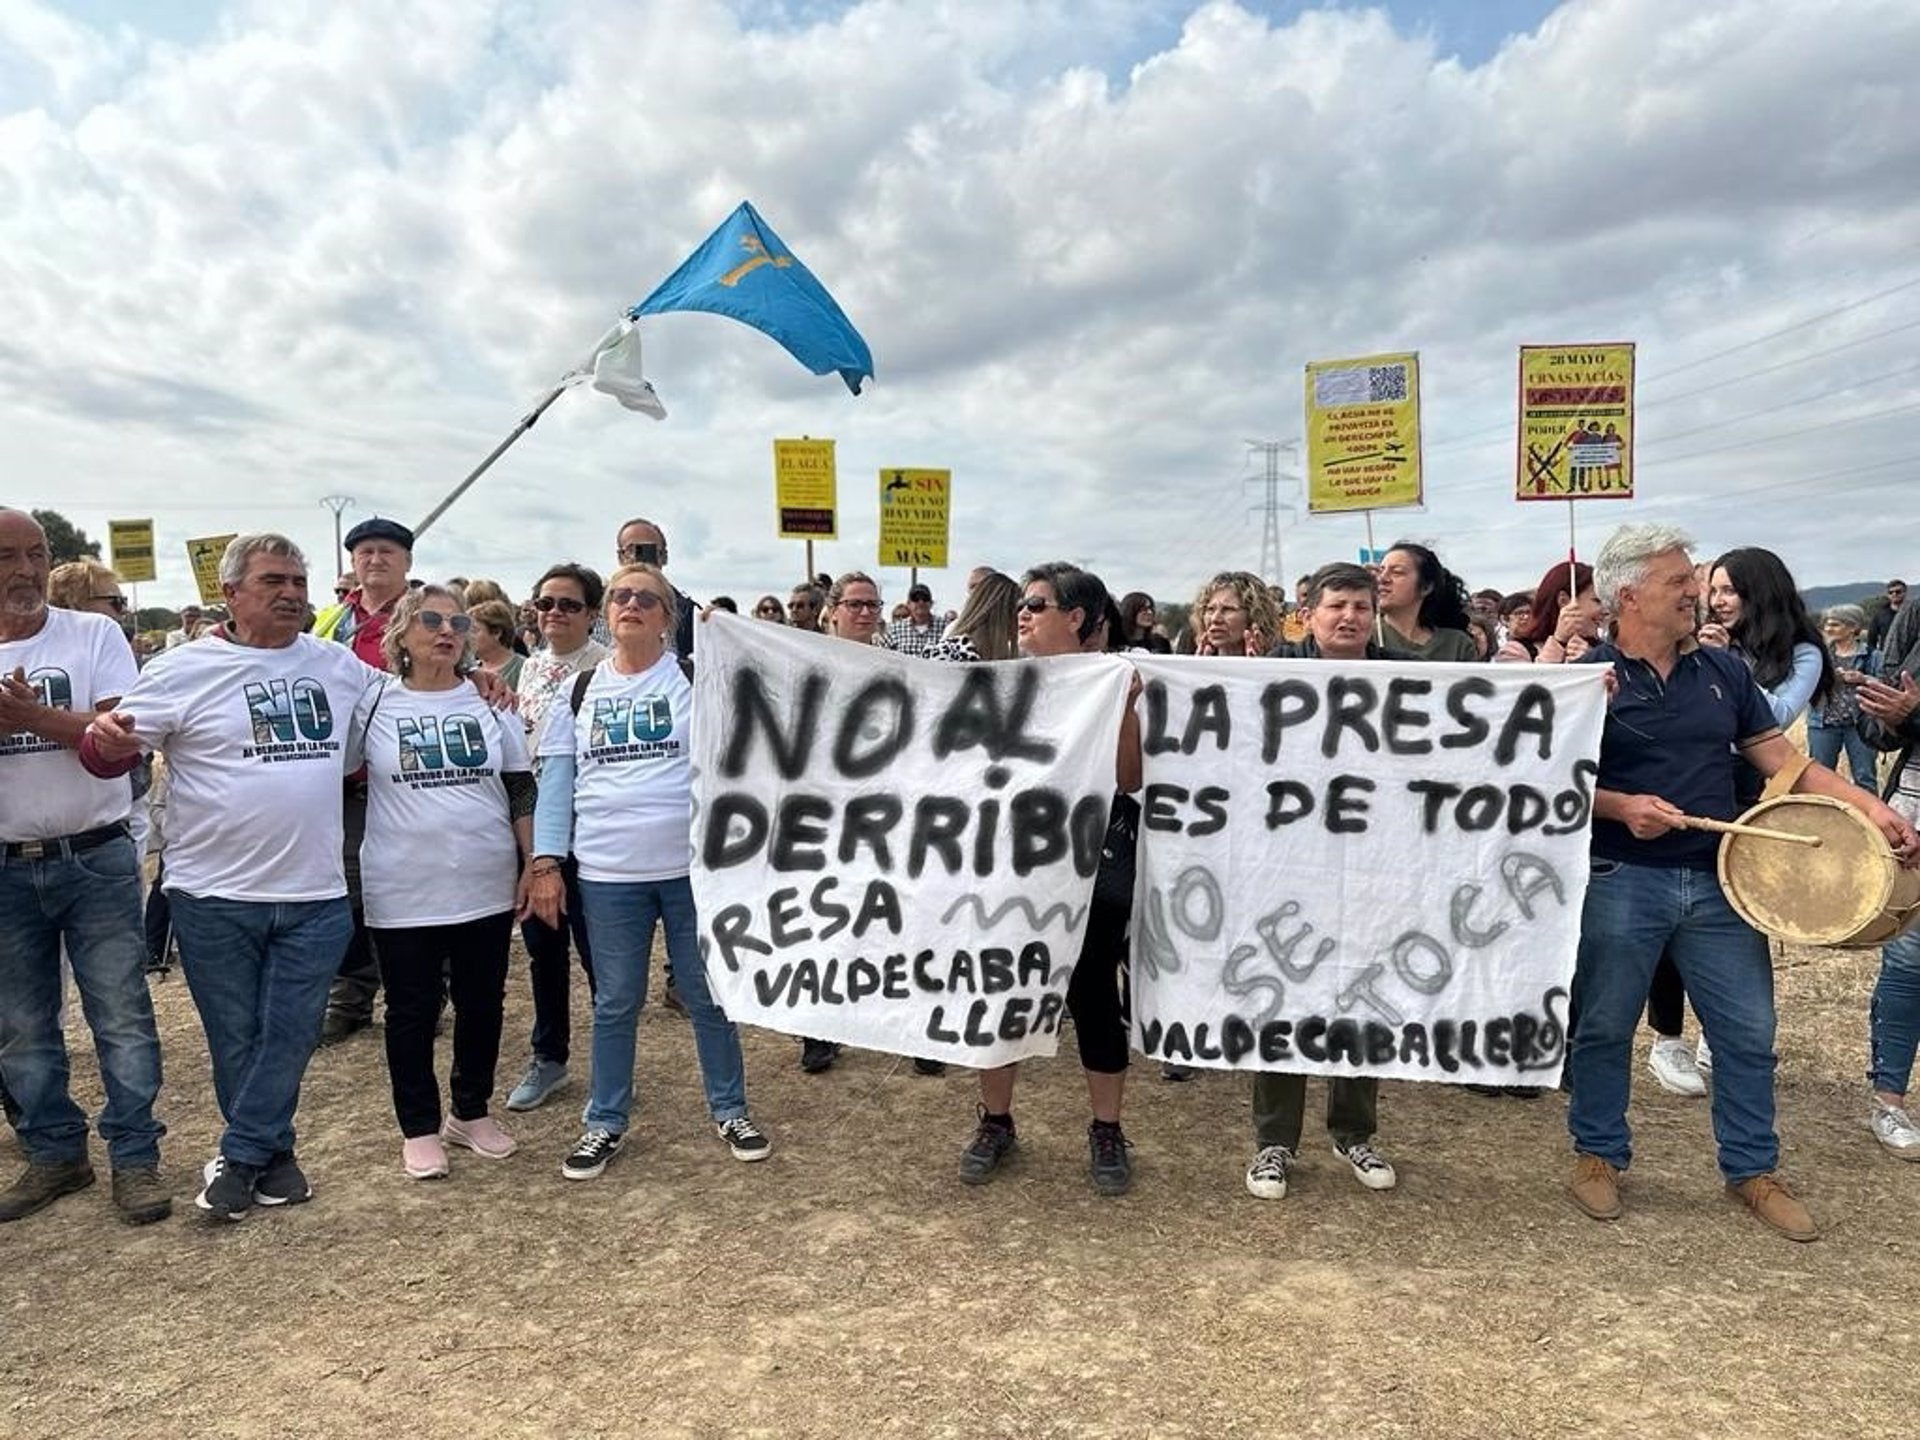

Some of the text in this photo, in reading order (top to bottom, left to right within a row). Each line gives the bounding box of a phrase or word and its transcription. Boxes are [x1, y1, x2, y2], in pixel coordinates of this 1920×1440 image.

[1529, 369, 1623, 383] URNAS VACÍAS
[1550, 354, 1606, 366] 28 MAYO
[1527, 425, 1567, 435] PODER
[884, 508, 945, 520] HAY VIDA
[896, 496, 945, 507] AGUA NO
[914, 478, 944, 492] SIN
[896, 547, 931, 564] MÁS
[243, 677, 333, 745] NO
[396, 714, 488, 771] NO
[590, 693, 673, 748] NO
[719, 663, 1057, 780] NO AL
[1143, 676, 1557, 765] LA PRESA
[702, 766, 1107, 879] DERRIBO
[1143, 759, 1600, 836] ES DE TODOS
[700, 877, 902, 973] RESA
[1336, 852, 1567, 1027] TOCA
[754, 941, 1051, 1007] VALDECABA
[1222, 901, 1336, 1032] SE
[1139, 987, 1568, 1073] VALDECABALLEROS
